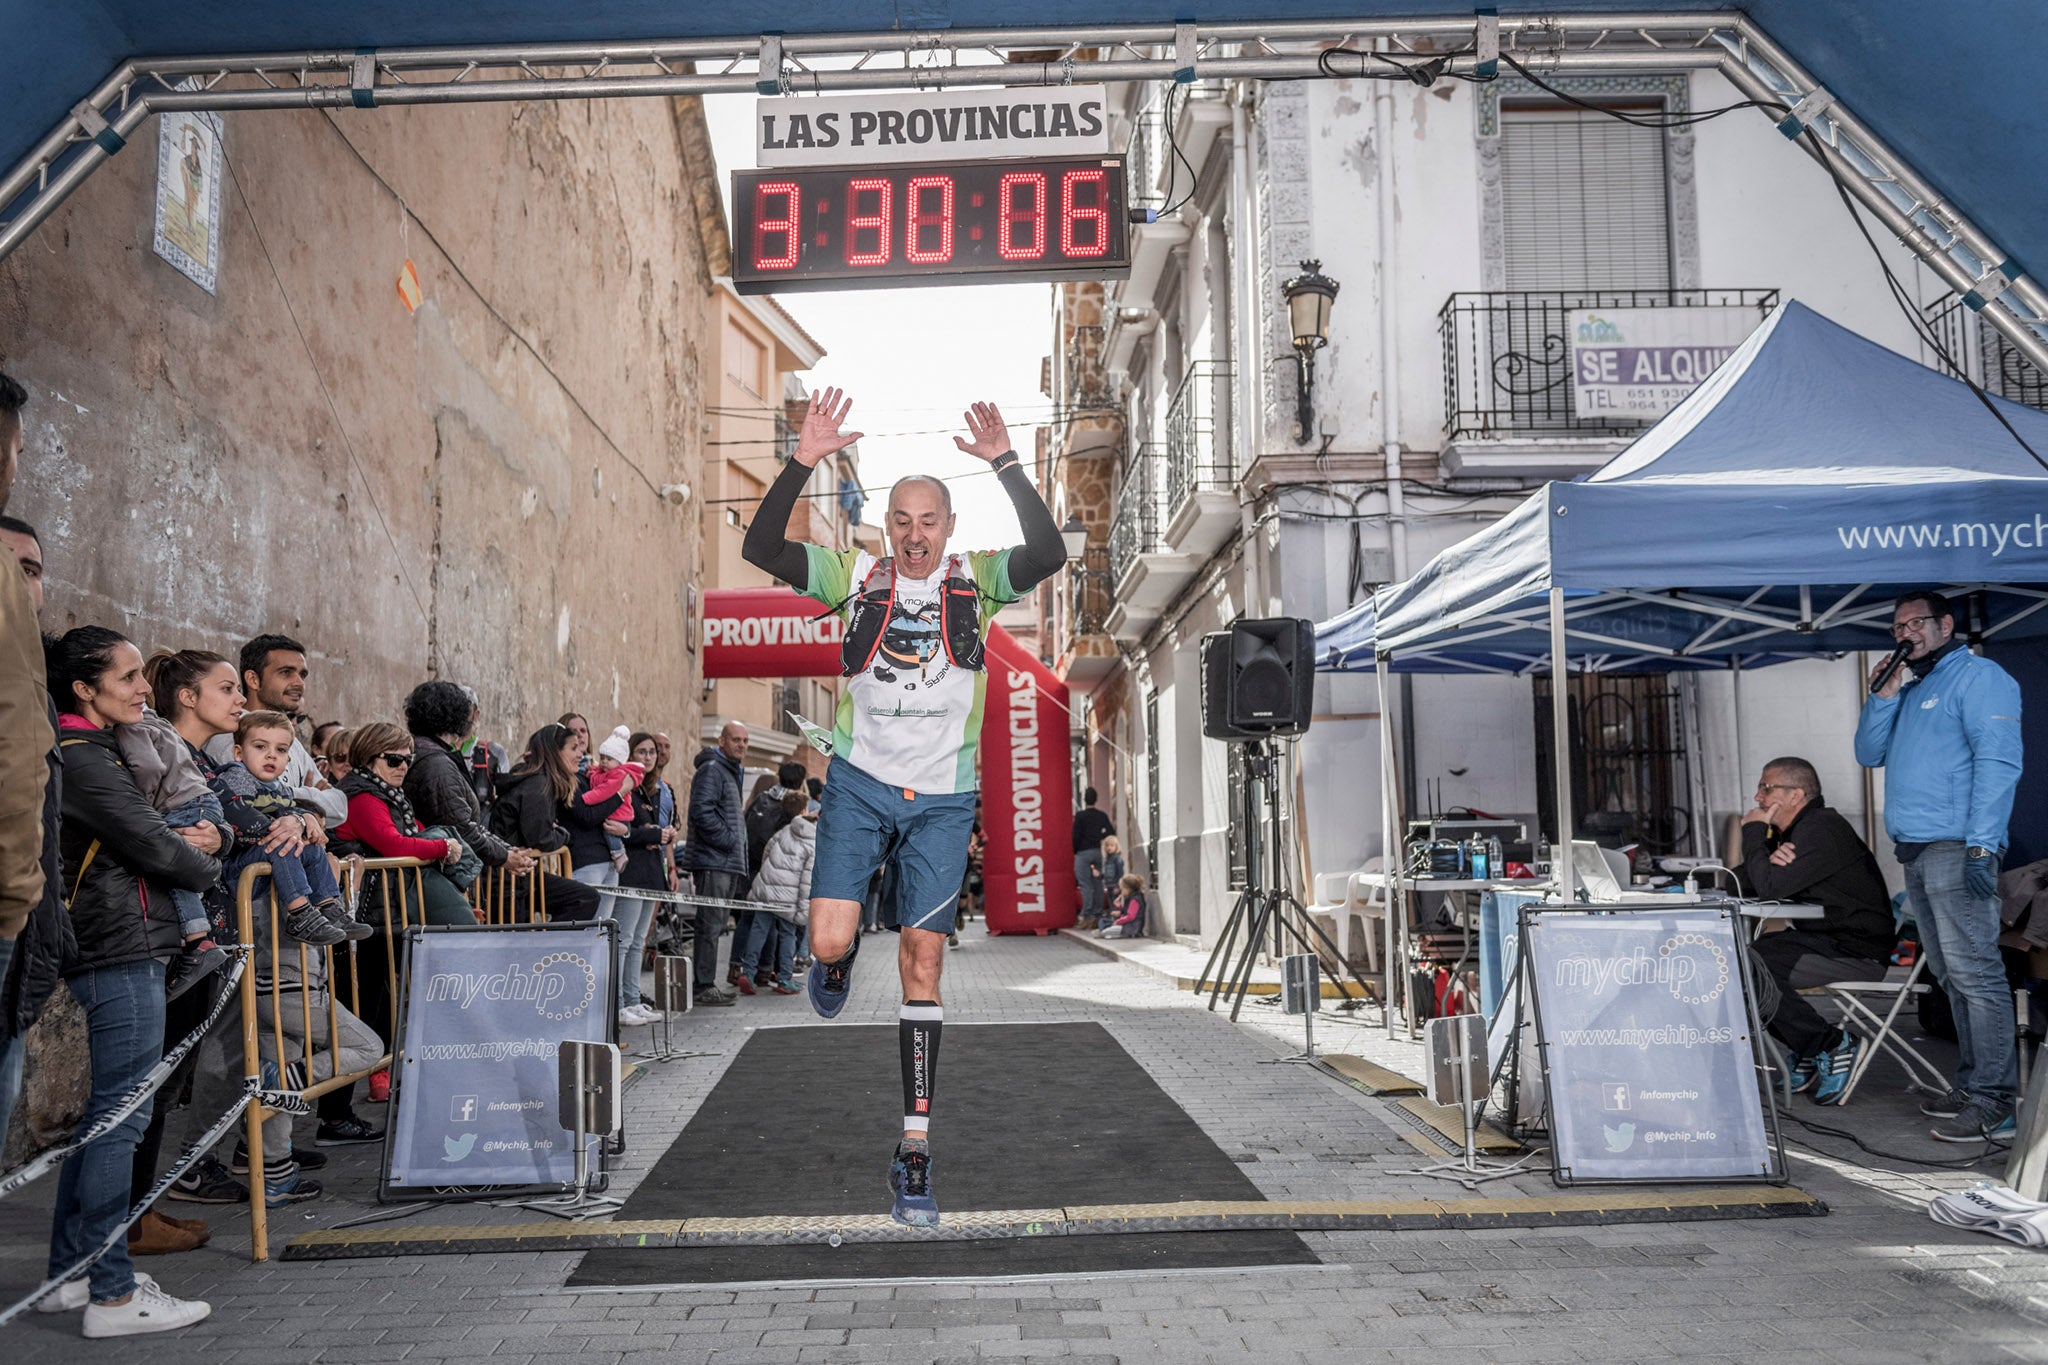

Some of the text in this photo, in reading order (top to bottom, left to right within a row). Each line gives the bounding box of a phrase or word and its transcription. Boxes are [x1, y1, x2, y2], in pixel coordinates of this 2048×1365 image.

[762, 101, 1103, 149] LAS PROVINCIAS
[1582, 350, 1620, 383] SE
[1007, 670, 1046, 913] LAS PROVINCIAS
[1555, 946, 1696, 995] mychip
[426, 964, 565, 1009] mychip
[1560, 1024, 1733, 1049] www.mychip.es
[486, 1099, 545, 1113] /infomychip
[1640, 1089, 1699, 1101] /infomychip
[483, 1139, 553, 1153] @Mychip_Info
[1644, 1130, 1717, 1144] @Mychip_Info
